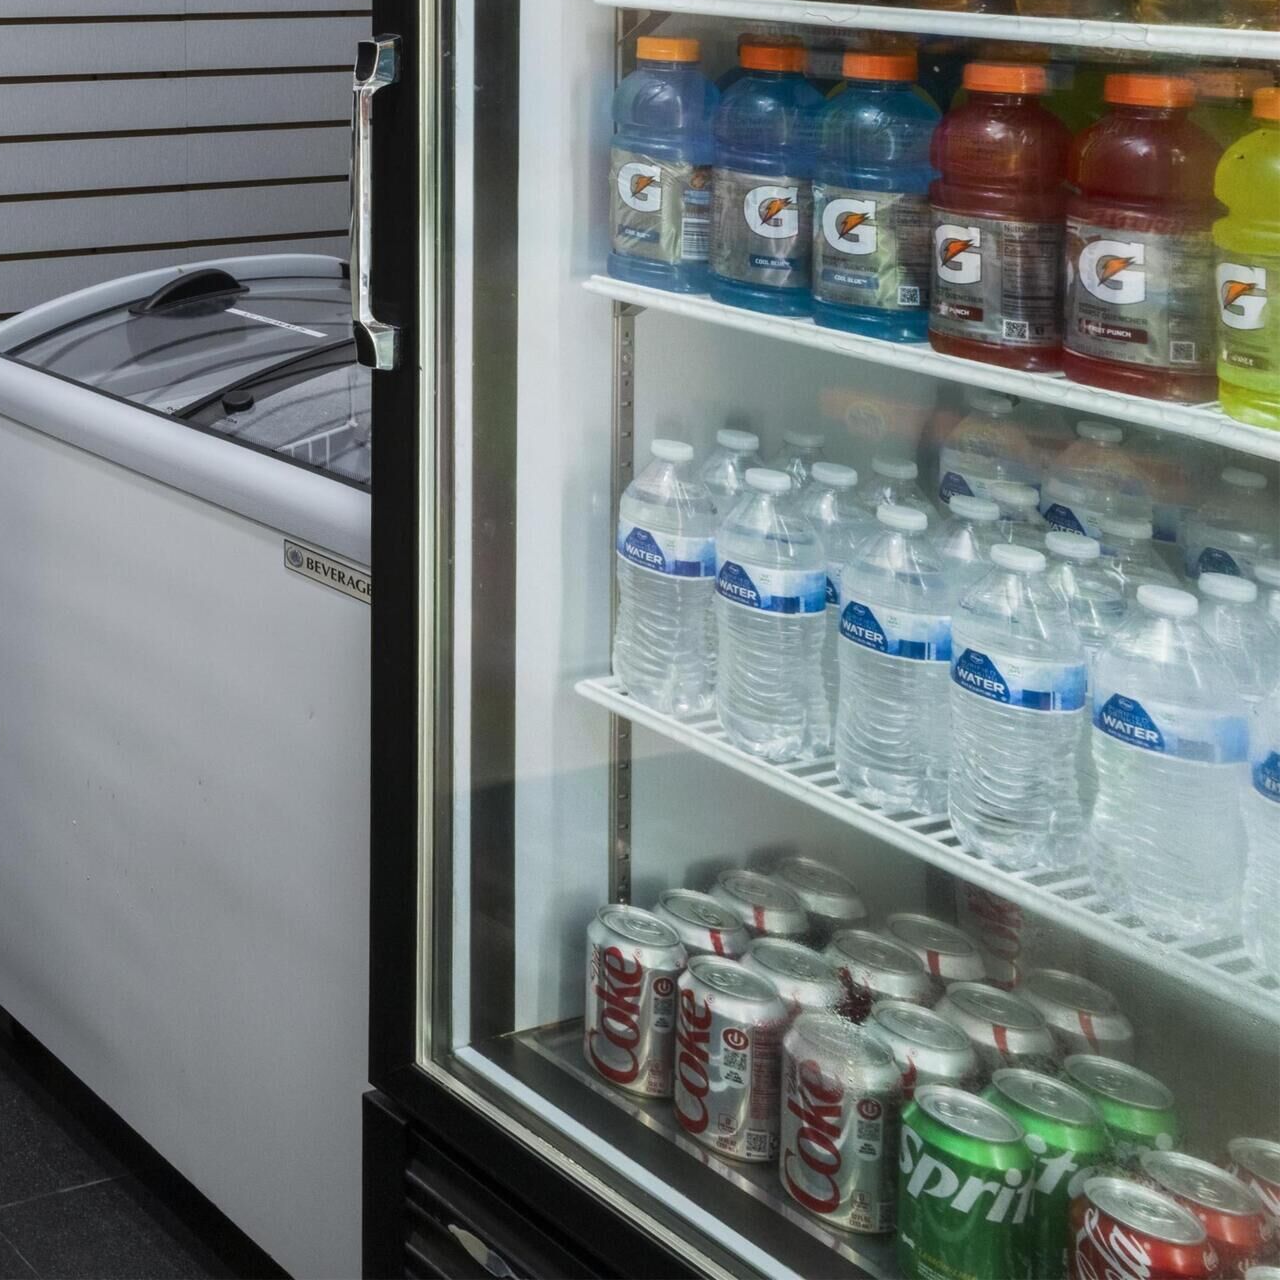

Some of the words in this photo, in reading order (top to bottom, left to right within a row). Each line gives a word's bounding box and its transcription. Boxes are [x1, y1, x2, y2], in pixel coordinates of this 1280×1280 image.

[617, 162, 662, 213] G
[744, 185, 799, 239] G
[822, 198, 878, 255] G
[935, 224, 982, 284] G
[1078, 239, 1146, 305] G
[1216, 262, 1268, 330] G
[1106, 328, 1132, 338] PUNCH
[624, 542, 663, 566] WATER
[719, 578, 758, 602] WATER
[842, 619, 884, 644] WATER
[956, 666, 1006, 695] WATER
[1102, 712, 1159, 744] WATER
[590, 946, 643, 1084] Coke
[674, 989, 712, 1135] Coke
[784, 1059, 844, 1214] Coke
